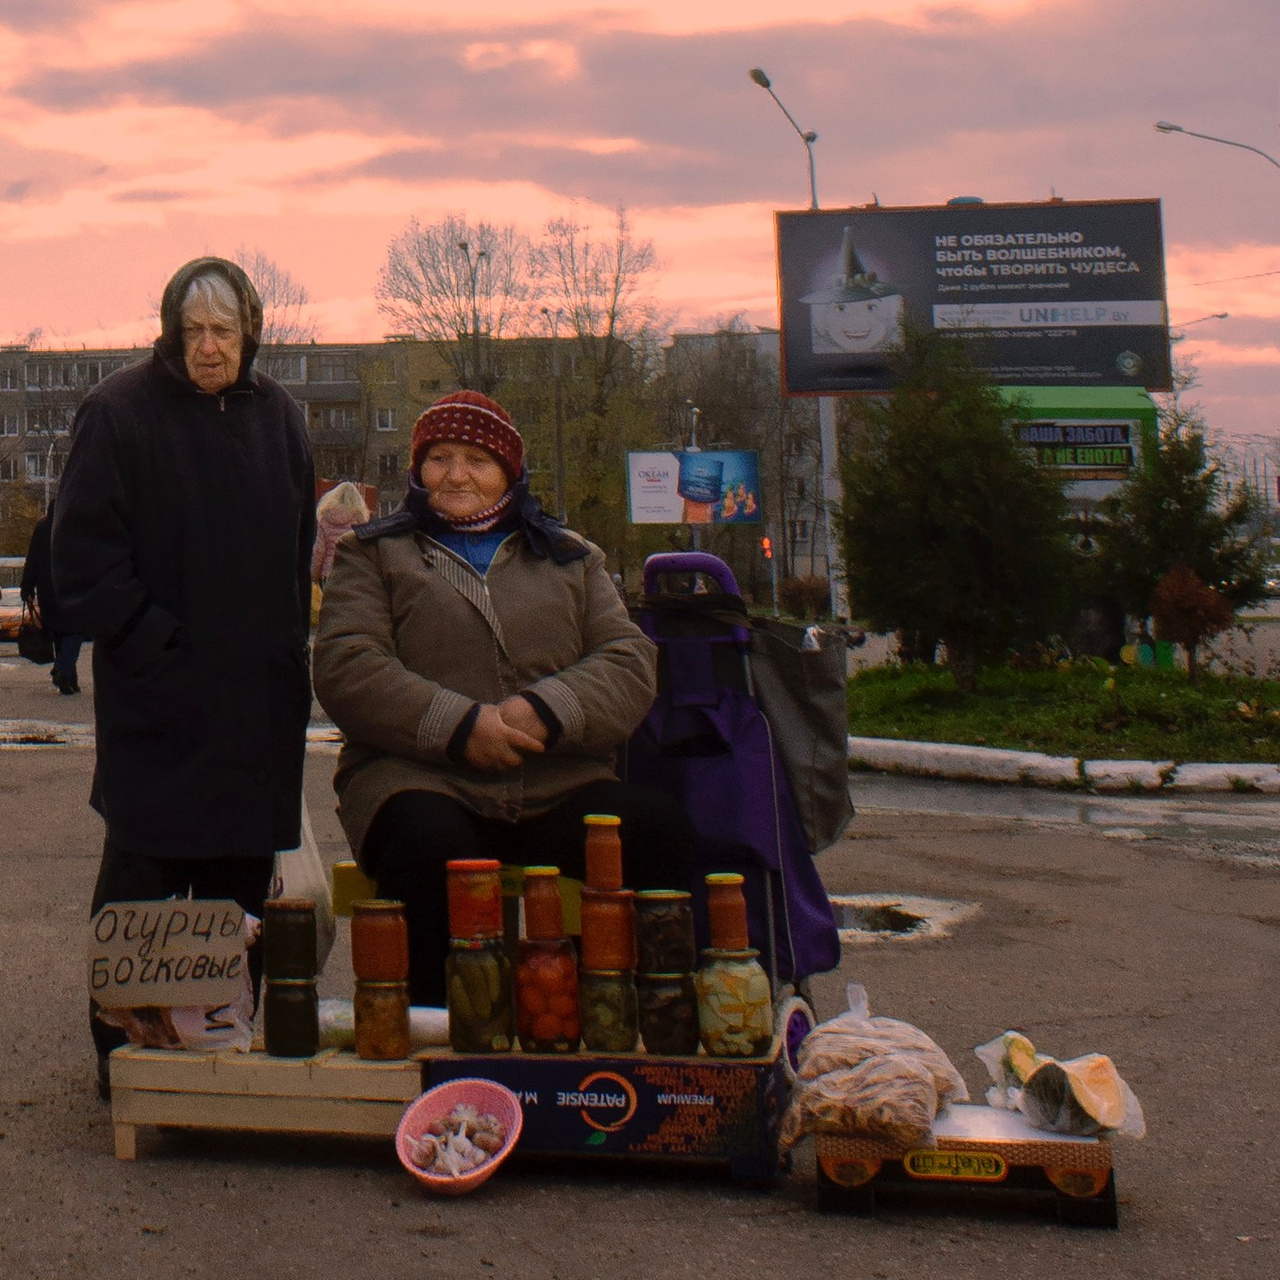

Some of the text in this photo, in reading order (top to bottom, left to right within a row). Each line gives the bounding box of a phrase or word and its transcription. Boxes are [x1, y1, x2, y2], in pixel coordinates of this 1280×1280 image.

[935, 231, 1084, 247] НЕ ОБЯЗАТЕЛЬНО
[935, 245, 1127, 262] БЫТЬ ВОЛШЕБНИКОМ,
[936, 260, 1141, 277] чтобы ТВОРИТЬ ЧУДЕСА
[556, 1091, 626, 1108] PATENSIE
[656, 1093, 714, 1106] PREMIUM
